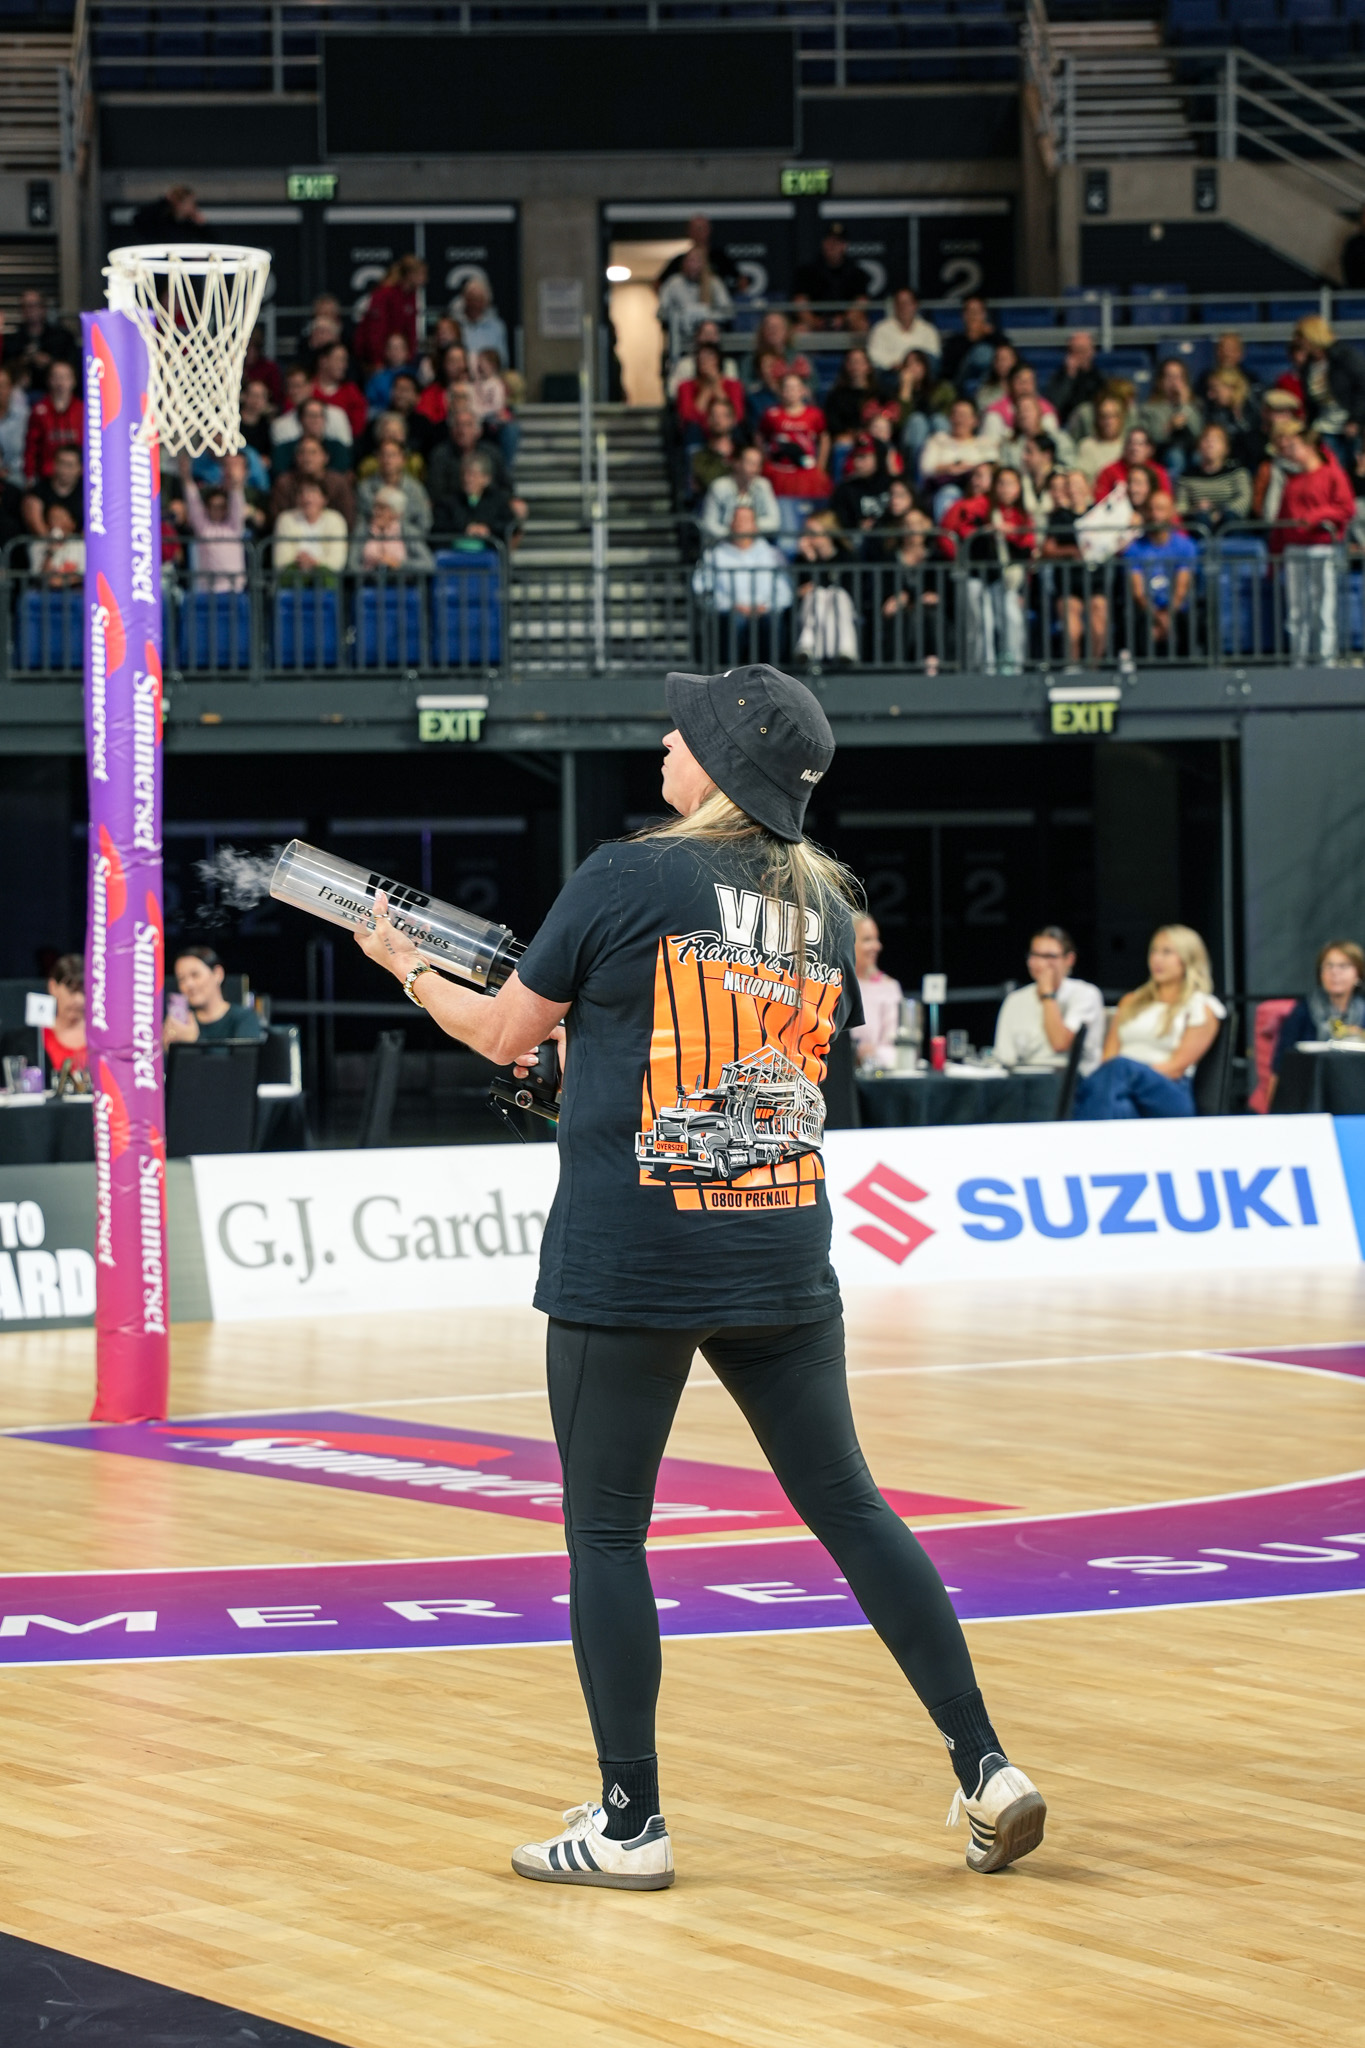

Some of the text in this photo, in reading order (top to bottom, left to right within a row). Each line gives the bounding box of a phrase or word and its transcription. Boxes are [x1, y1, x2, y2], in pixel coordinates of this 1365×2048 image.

[86, 355, 106, 535] Summerset
[91, 603, 110, 782] Summerset
[418, 710, 486, 742] EXIT
[1051, 702, 1119, 735] EXIT
[132, 671, 161, 851] Summerset
[91, 853, 111, 1031] Summerset
[317, 885, 373, 918] Frames
[392, 916, 451, 950] Trusses
[670, 929, 763, 966] Frames
[766, 949, 784, 975] &
[714, 882, 822, 954] VIP
[132, 921, 160, 1091] Summerset
[656, 1142, 684, 1152] OVERSIZE
[754, 1107, 775, 1120] VIP
[95, 1091, 116, 1268] Summerset
[711, 1189, 791, 1208] 0800 PRENAIL
[956, 1165, 1319, 1242] SUZUKI
[138, 1155, 166, 1335] Summerset
[217, 1196, 336, 1285] G.J.
